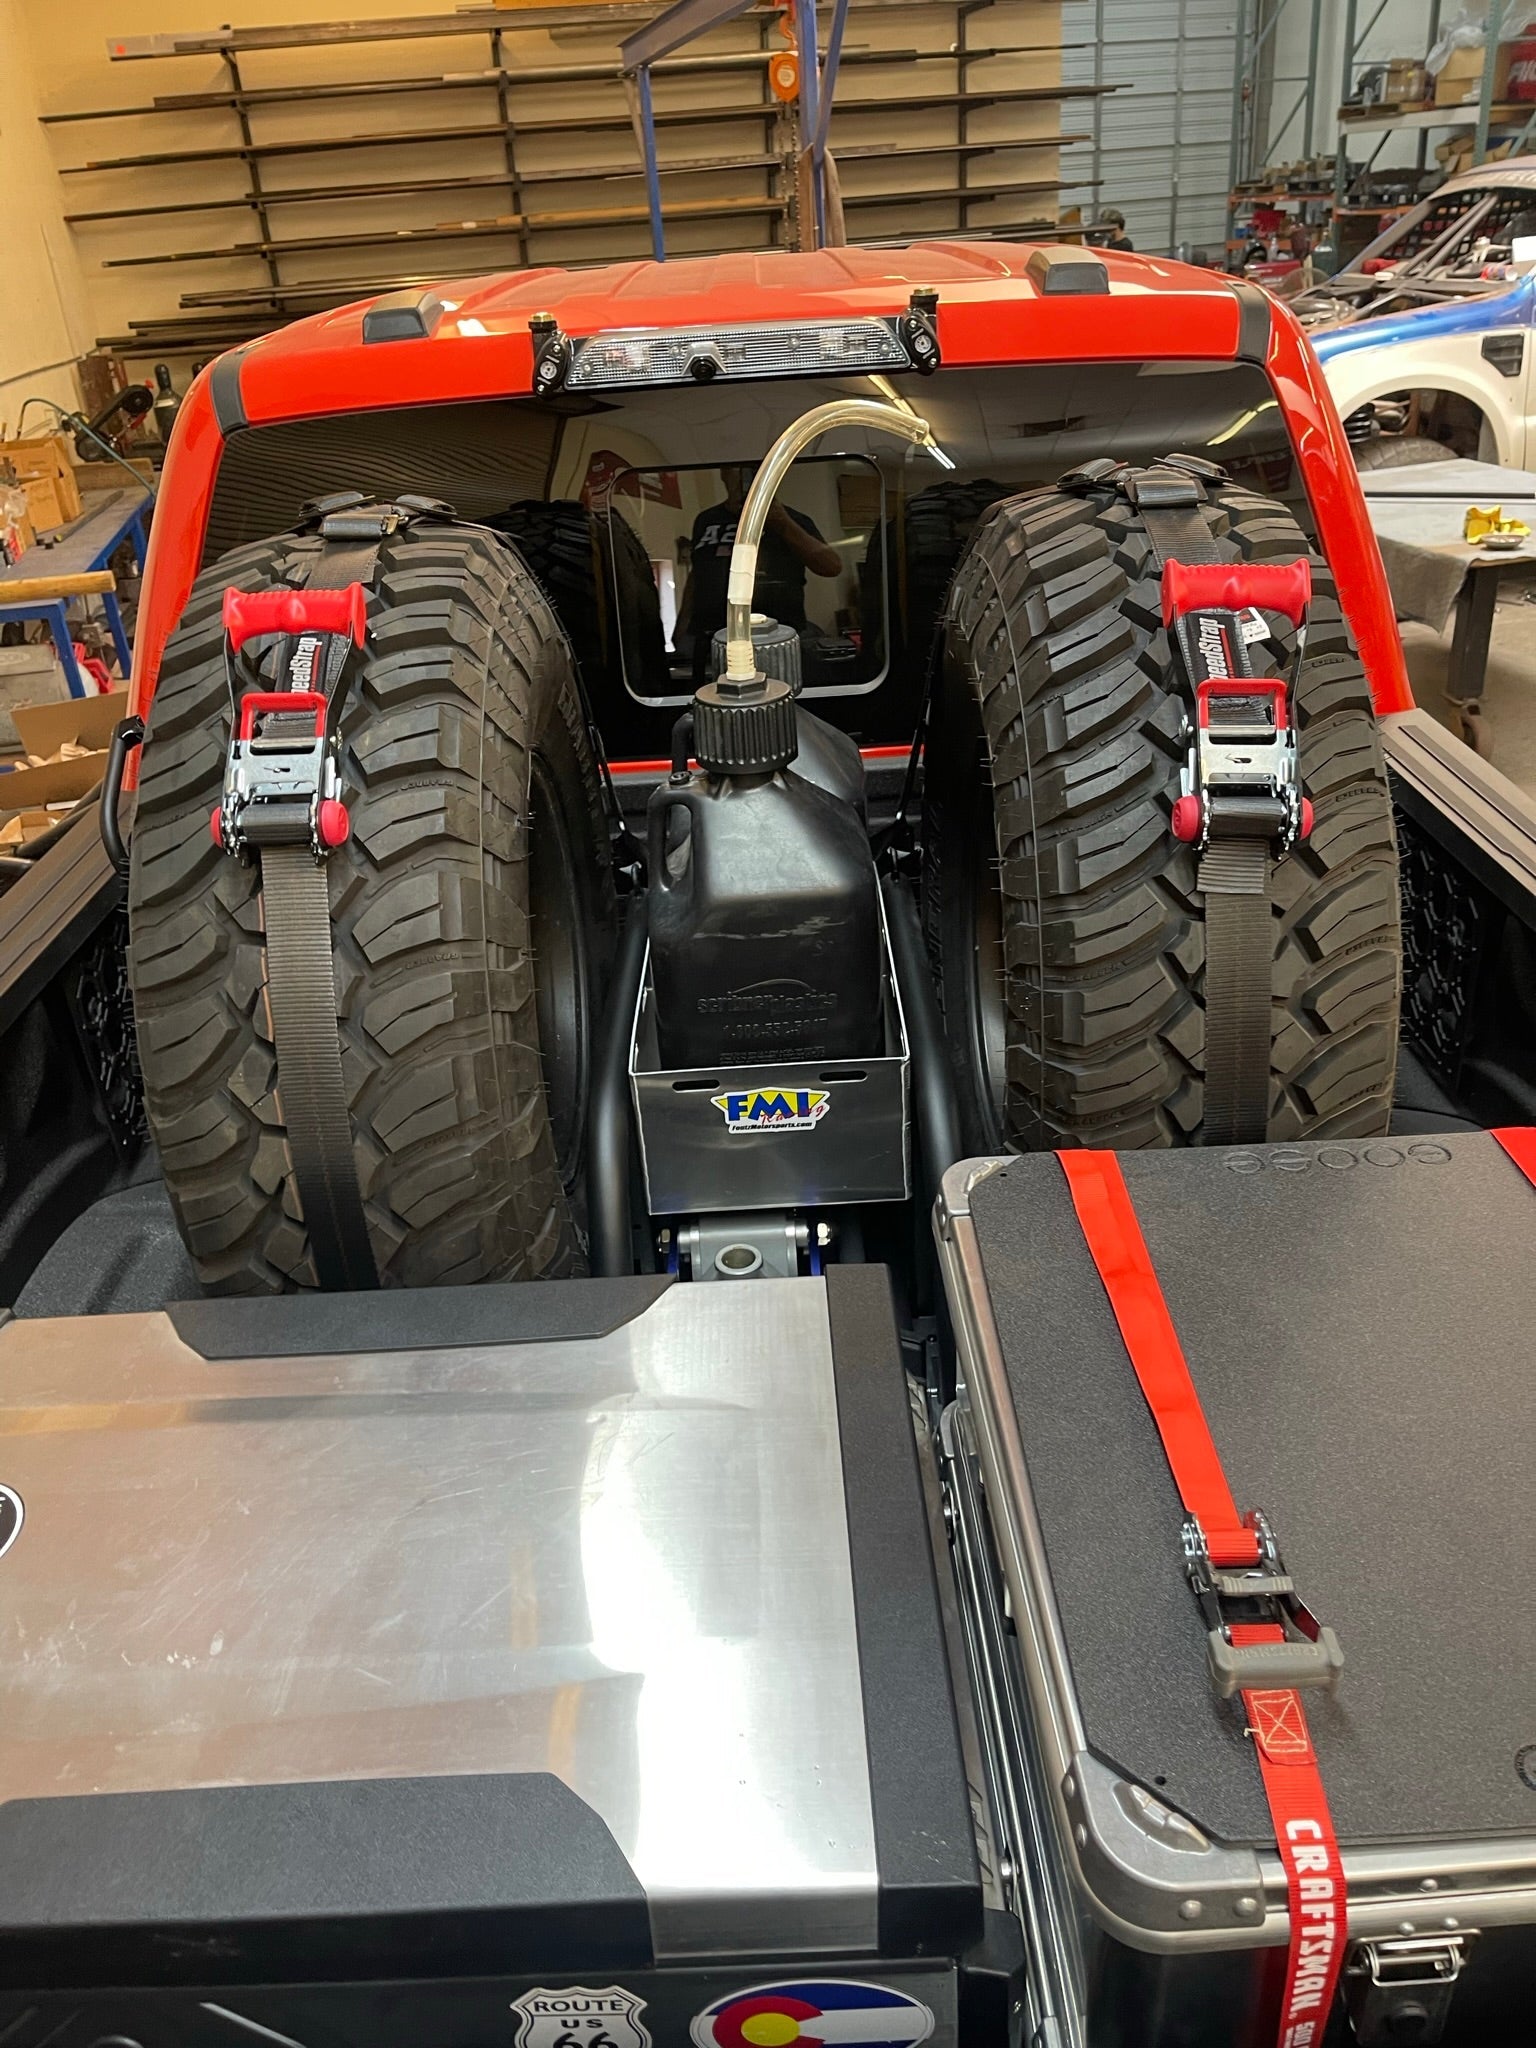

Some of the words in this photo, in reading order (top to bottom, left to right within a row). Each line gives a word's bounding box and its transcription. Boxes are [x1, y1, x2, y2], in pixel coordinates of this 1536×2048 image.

[1199, 617, 1229, 680] eedStrap
[289, 637, 323, 694] eedStrap
[727, 1091, 810, 1121] FMI
[533, 2000, 625, 2013] ROUTE
[560, 2018, 604, 2029] US
